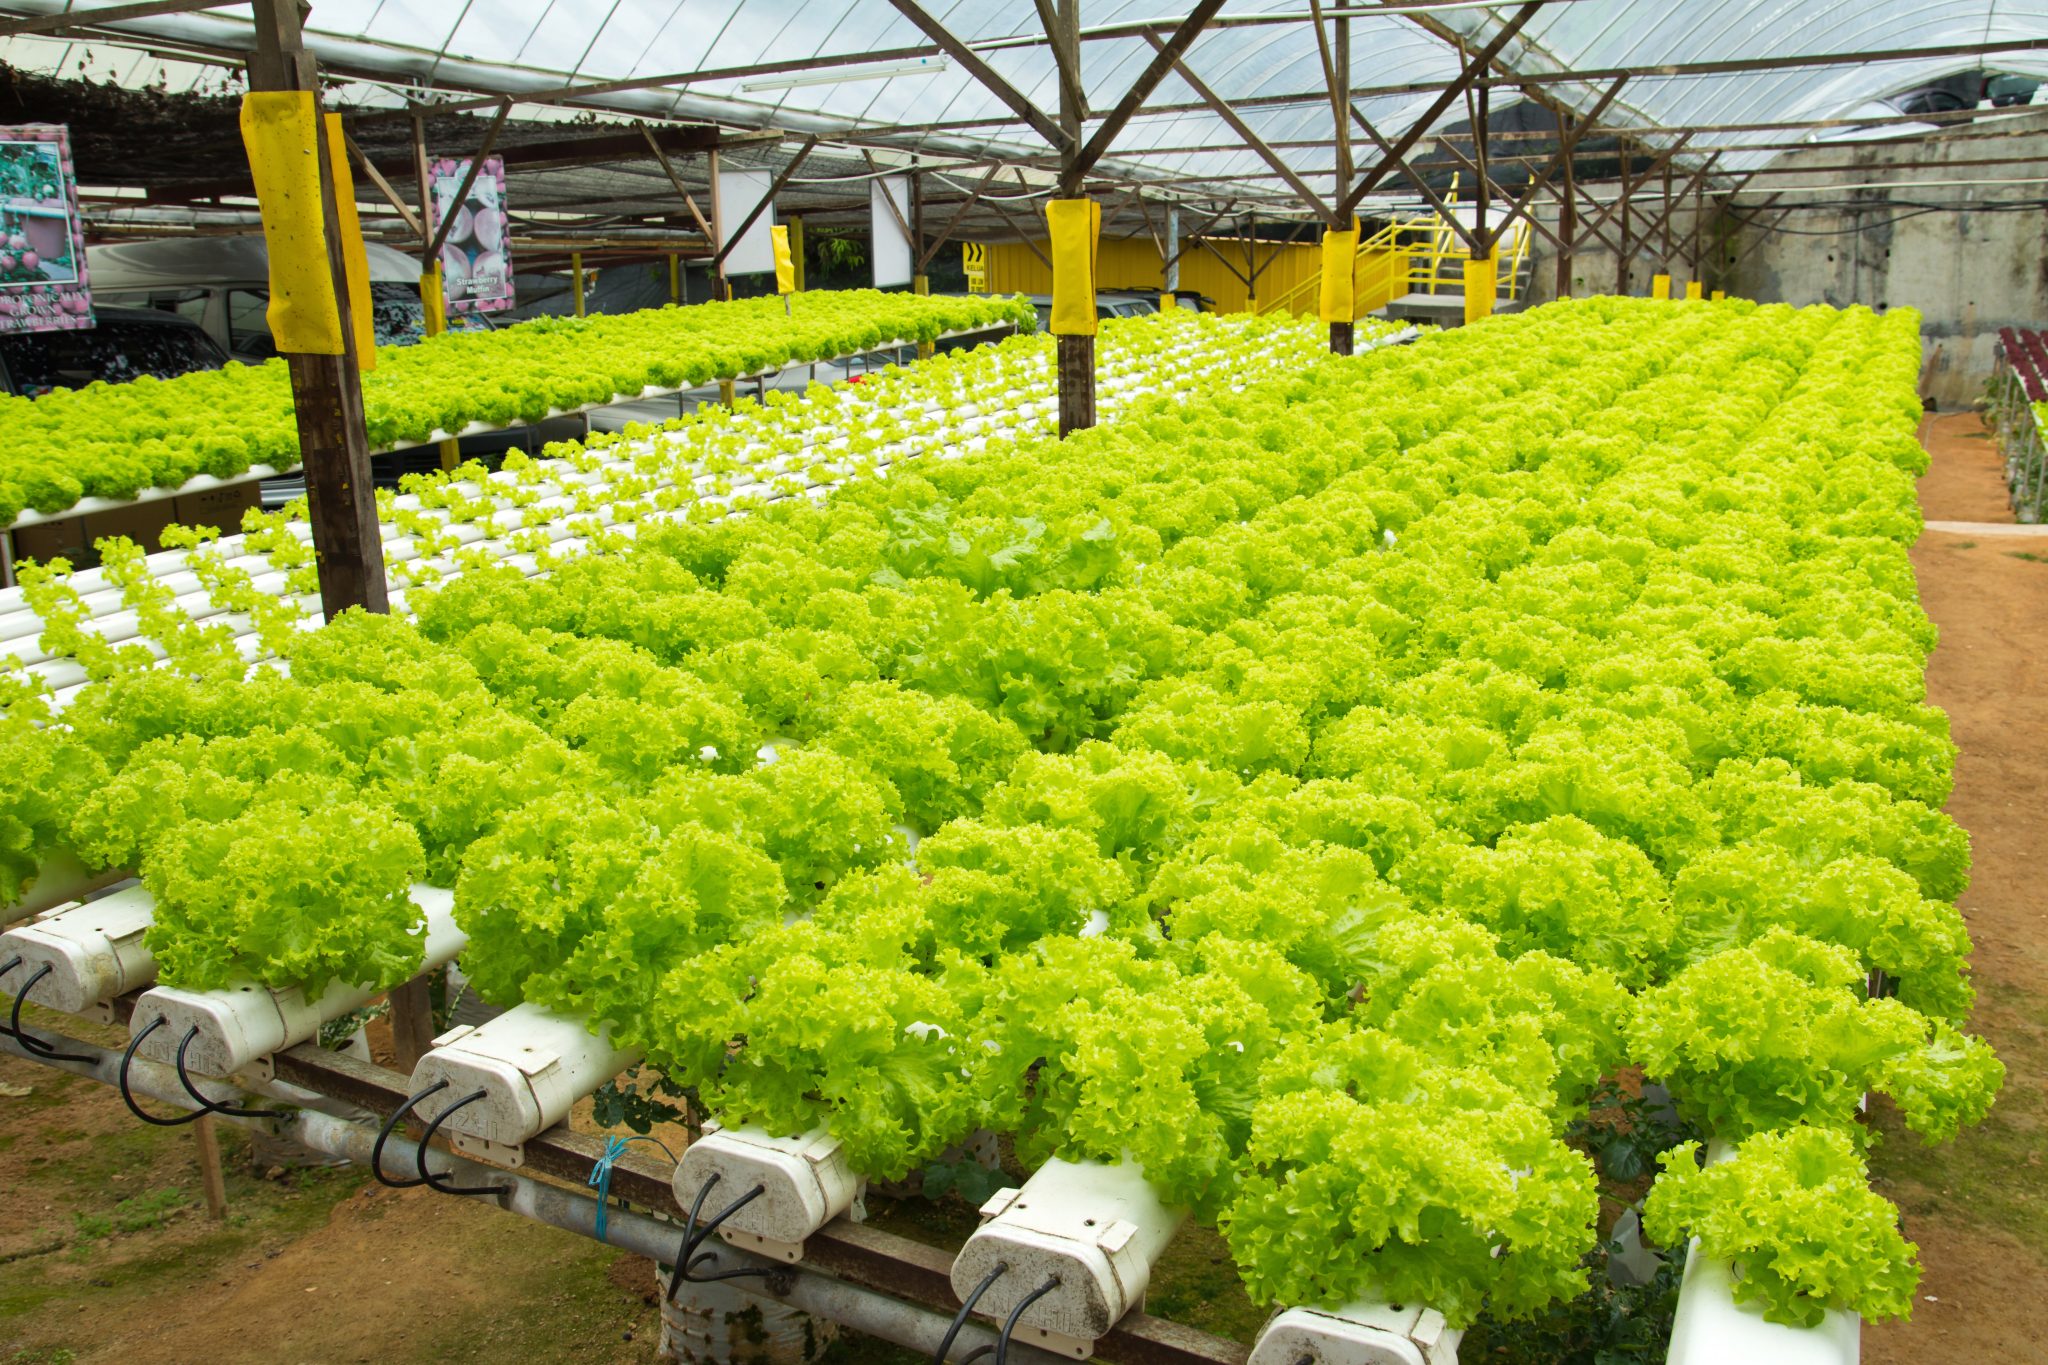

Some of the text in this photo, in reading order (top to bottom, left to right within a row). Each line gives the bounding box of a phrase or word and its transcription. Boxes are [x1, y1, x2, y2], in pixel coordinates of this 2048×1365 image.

[966, 264, 984, 272] KELUA
[456, 276, 498, 286] Strawberry
[466, 284, 490, 294] Muffin
[9, 304, 56, 317] GROWN
[0, 315, 77, 329] TRAWBERRIES
